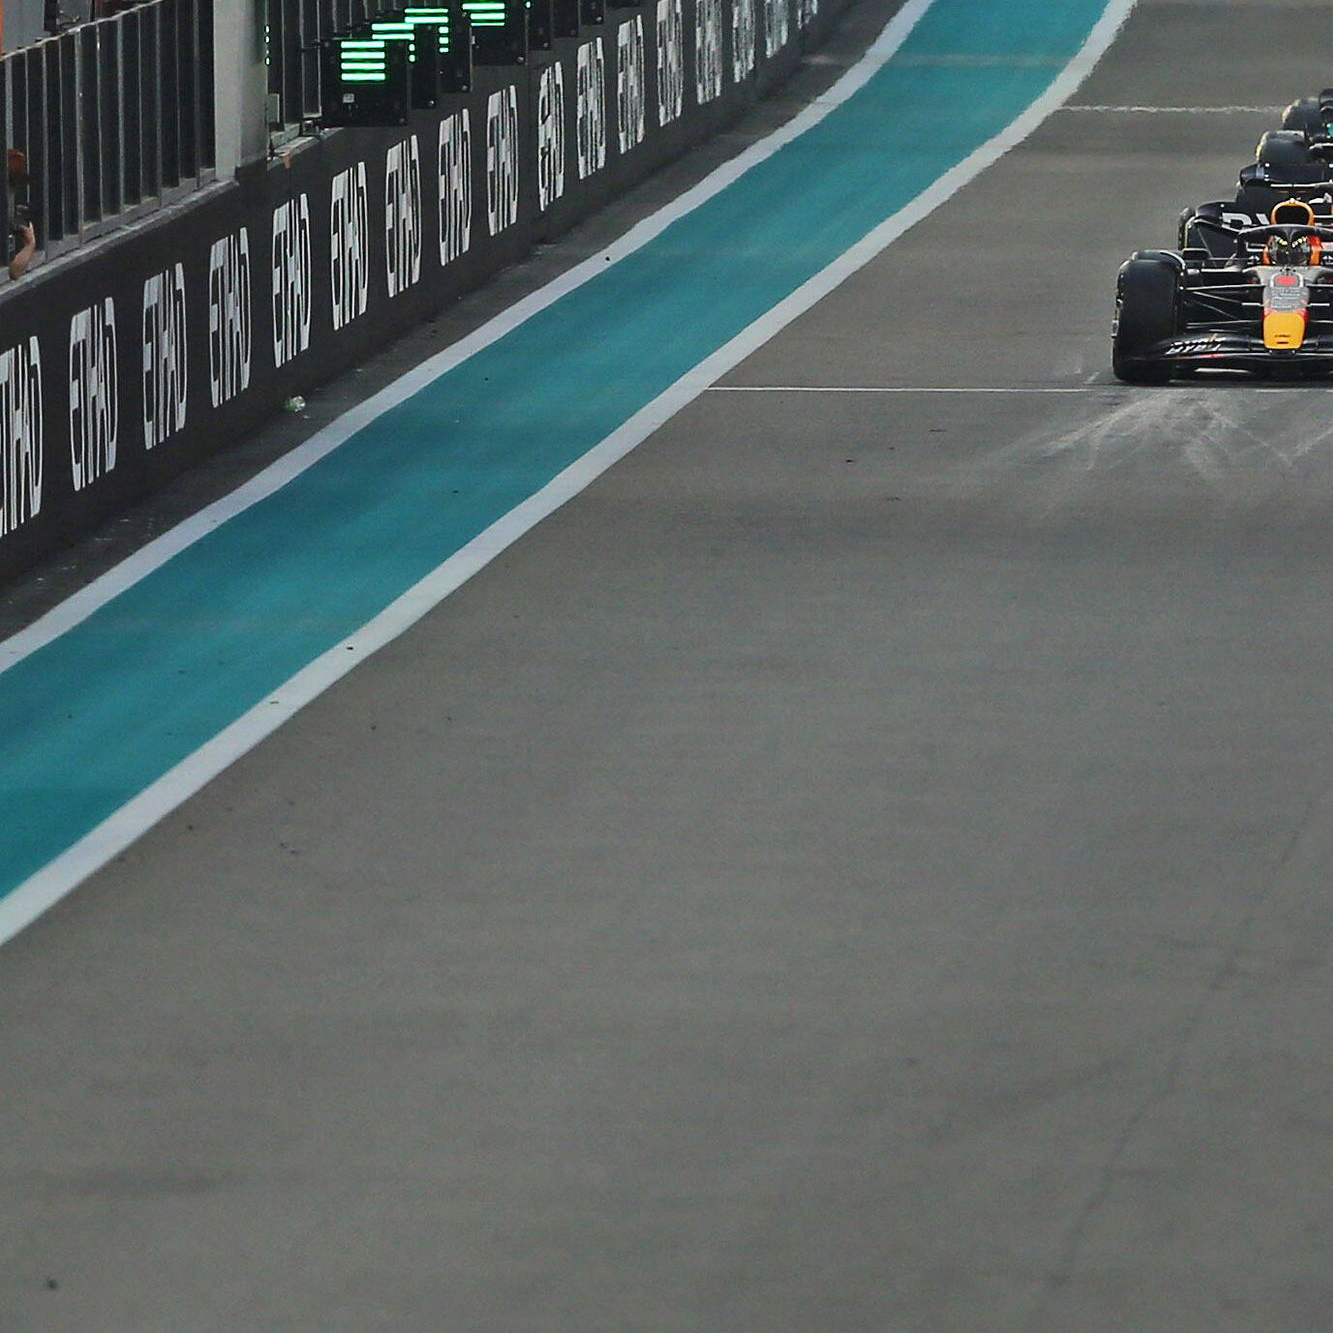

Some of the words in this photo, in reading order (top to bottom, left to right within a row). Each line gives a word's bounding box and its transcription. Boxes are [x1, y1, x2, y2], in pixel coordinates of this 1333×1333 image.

[331, 161, 369, 331] ETIHAD
[386, 134, 421, 298] ETIHAD
[438, 107, 472, 266] ETIHAD
[143, 262, 187, 450] ETIHAD
[209, 226, 250, 408] ETIHAD
[272, 192, 311, 368] ETIHAD
[0, 335, 43, 538] TIHAD
[70, 296, 118, 492] ETIHAD
